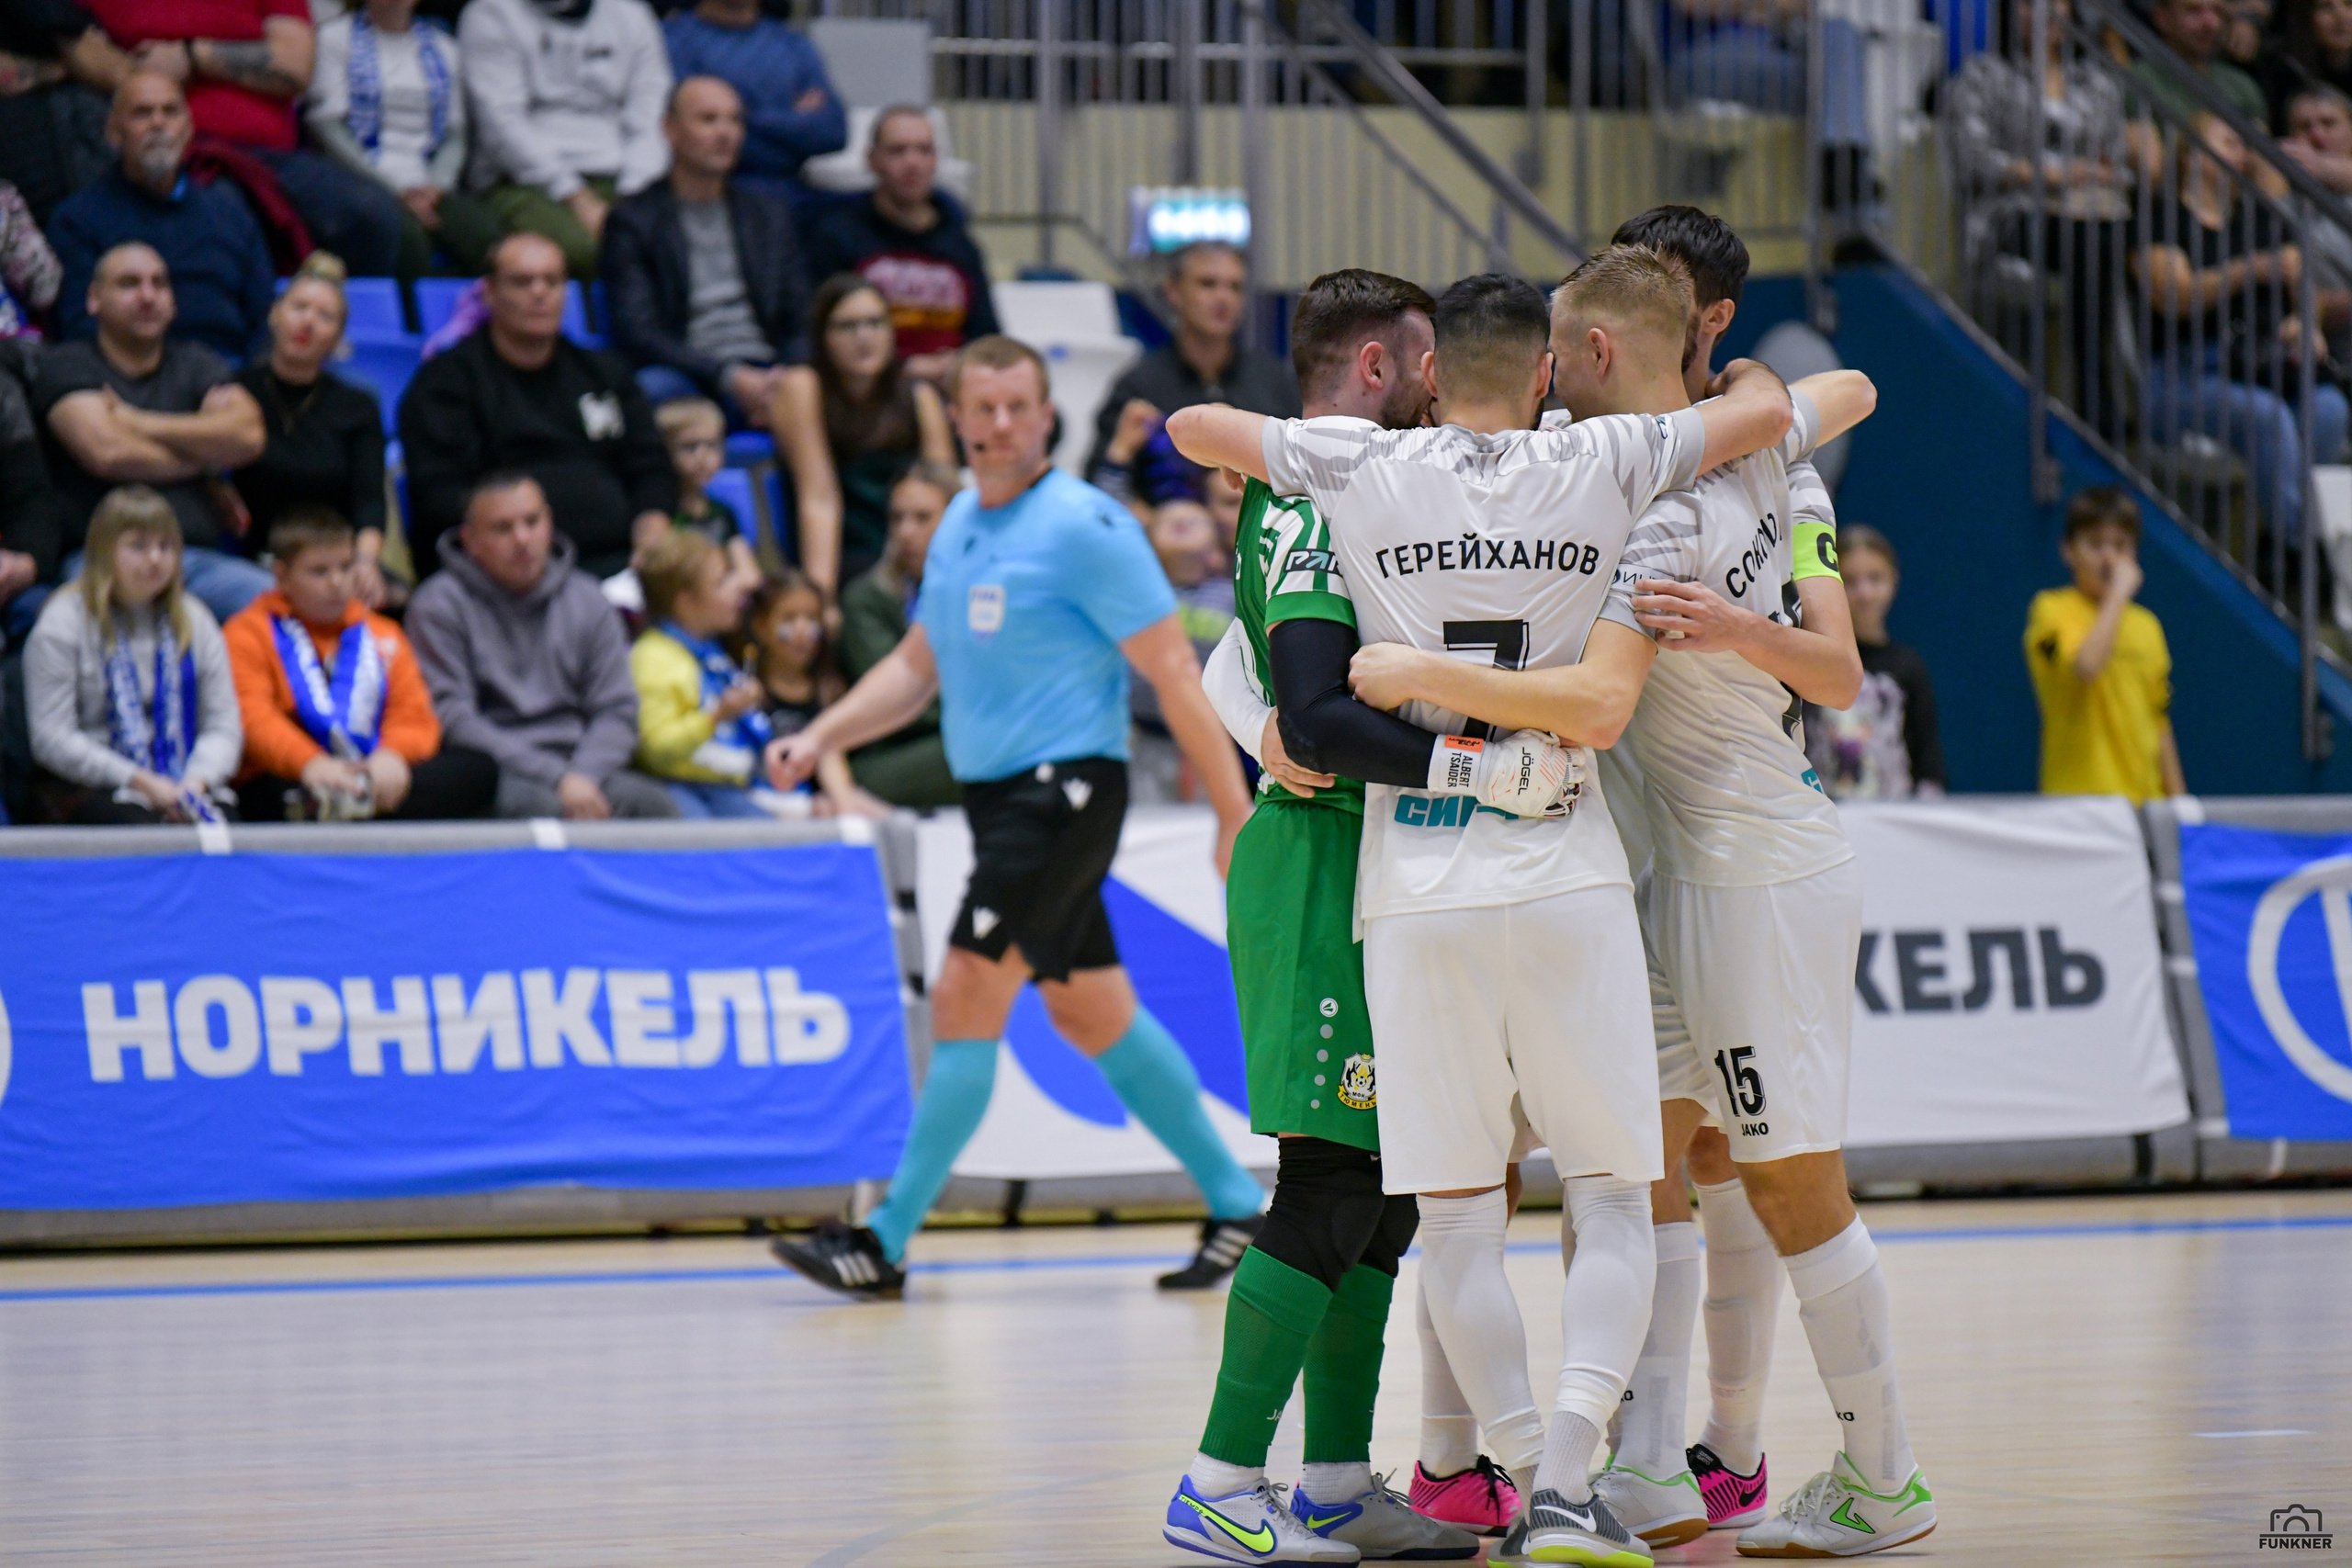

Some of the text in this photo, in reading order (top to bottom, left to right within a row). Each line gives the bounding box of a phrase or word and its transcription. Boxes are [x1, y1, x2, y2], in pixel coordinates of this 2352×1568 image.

[1375, 533, 1600, 579] ГЕРЕЙХАНОВ
[1447, 752, 1463, 788] TSAIDER
[1459, 755, 1474, 788] ALBERT
[1518, 747, 1534, 795] JÖGEL
[82, 966, 851, 1082] НОРНИКЕЛЬ
[1714, 1046, 1766, 1117] 15
[1741, 1122, 1770, 1136] JAKO
